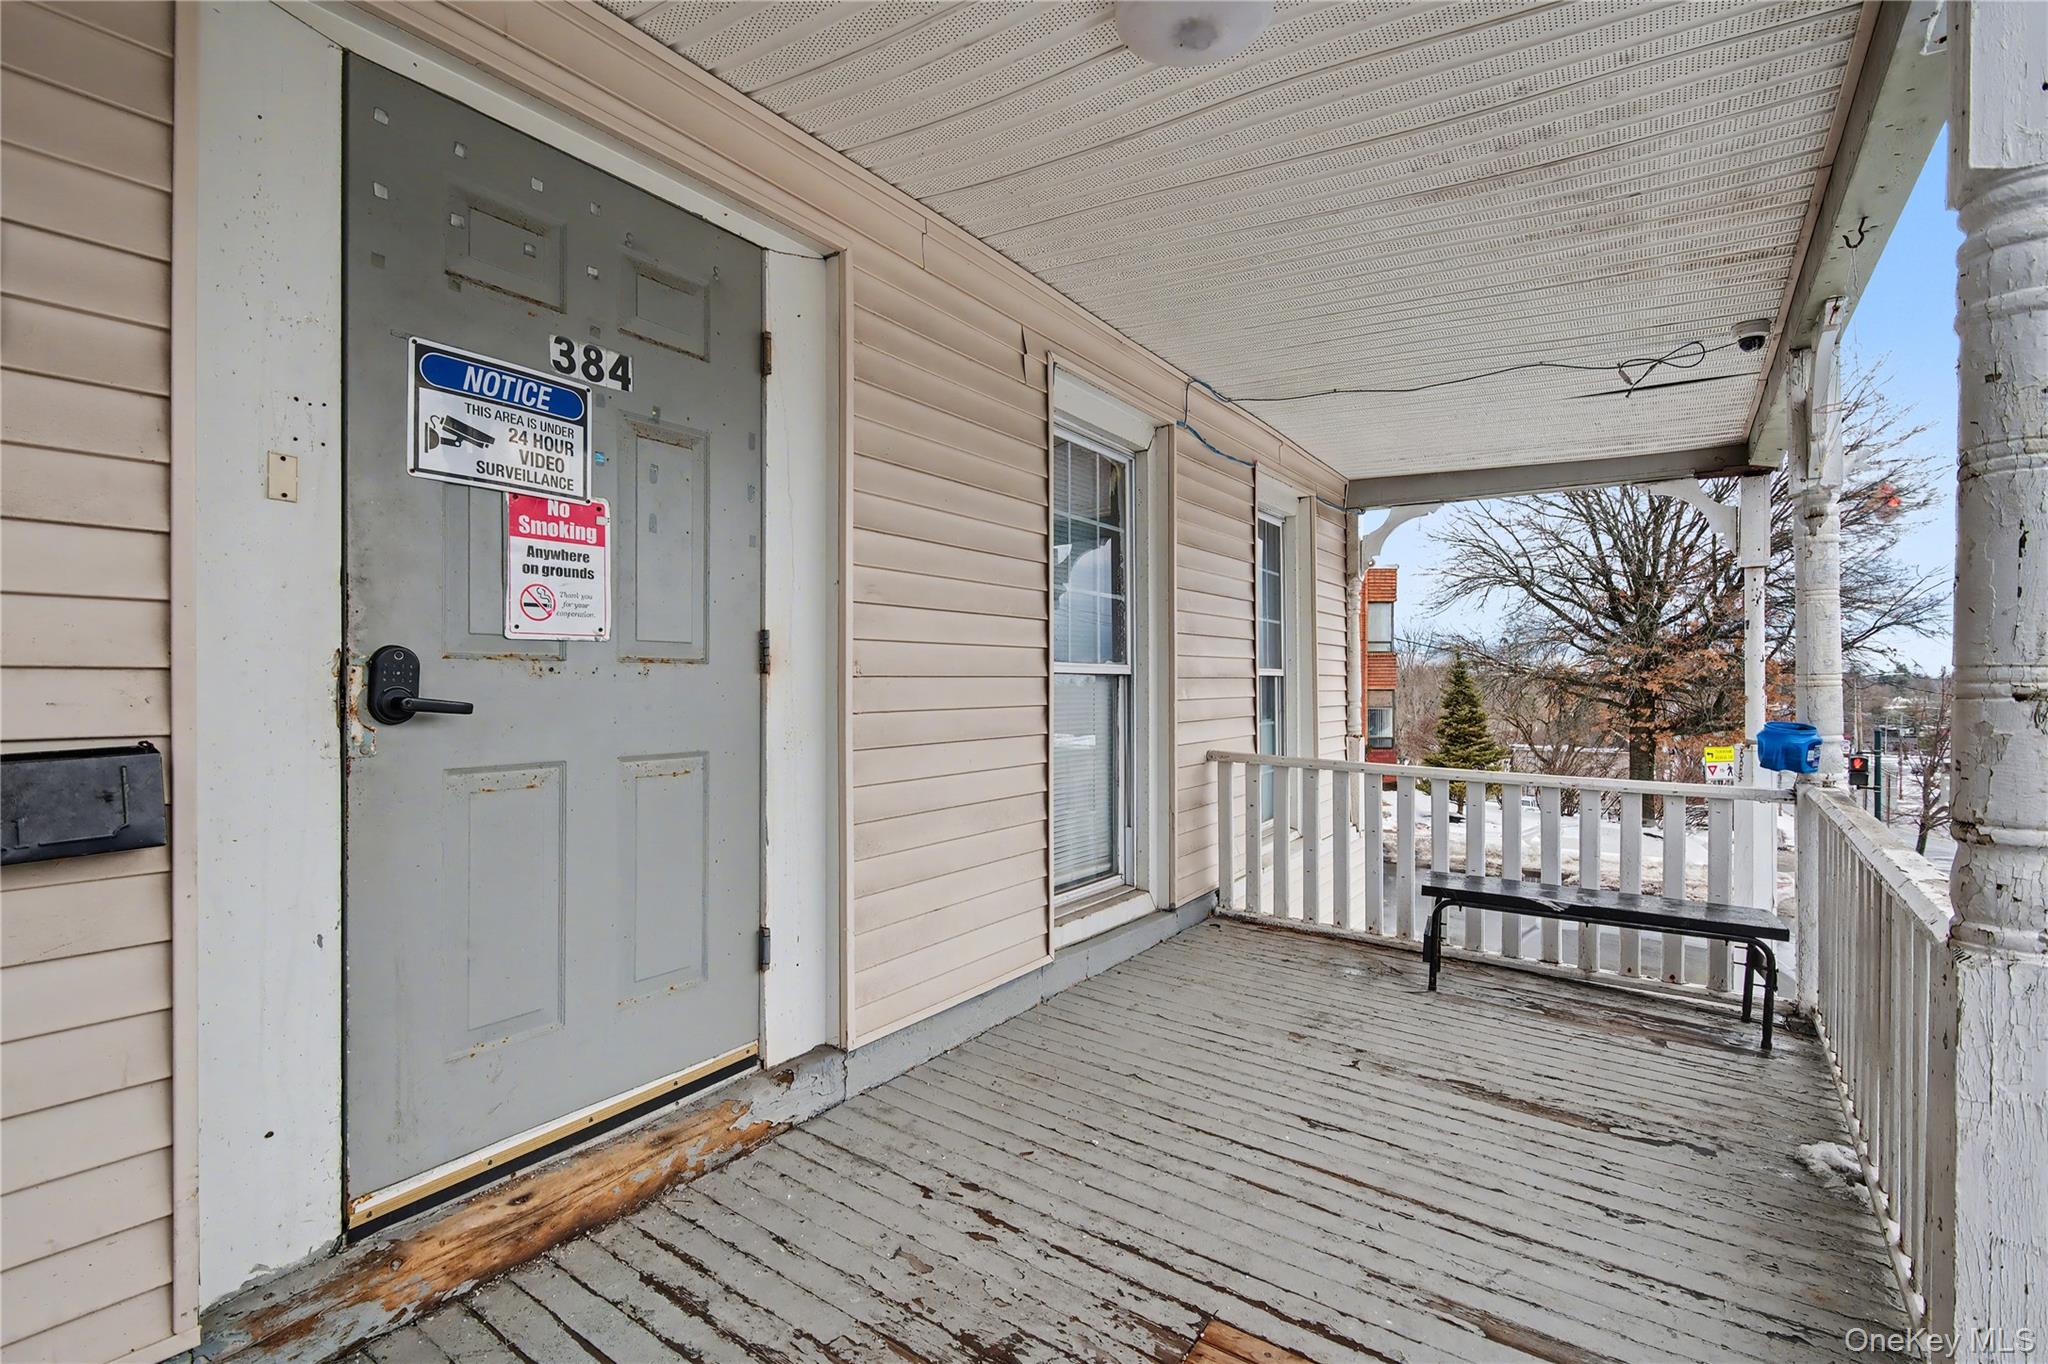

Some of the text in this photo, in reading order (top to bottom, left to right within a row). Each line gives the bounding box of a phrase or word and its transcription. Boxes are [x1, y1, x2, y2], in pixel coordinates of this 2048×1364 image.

[552, 335, 631, 391] 384
[462, 365, 552, 411] NOTICE
[464, 402, 574, 439] THIS AREA IS UNDER
[508, 427, 574, 457] 24 HOUR
[476, 460, 574, 491] SURVEILLANCE
[519, 449, 565, 473] VIDEO
[547, 499, 570, 518] No
[518, 515, 597, 544] Smoking
[526, 545, 590, 563] Anywhere
[522, 563, 595, 580] on grounds
[559, 591, 593, 602] Thank you
